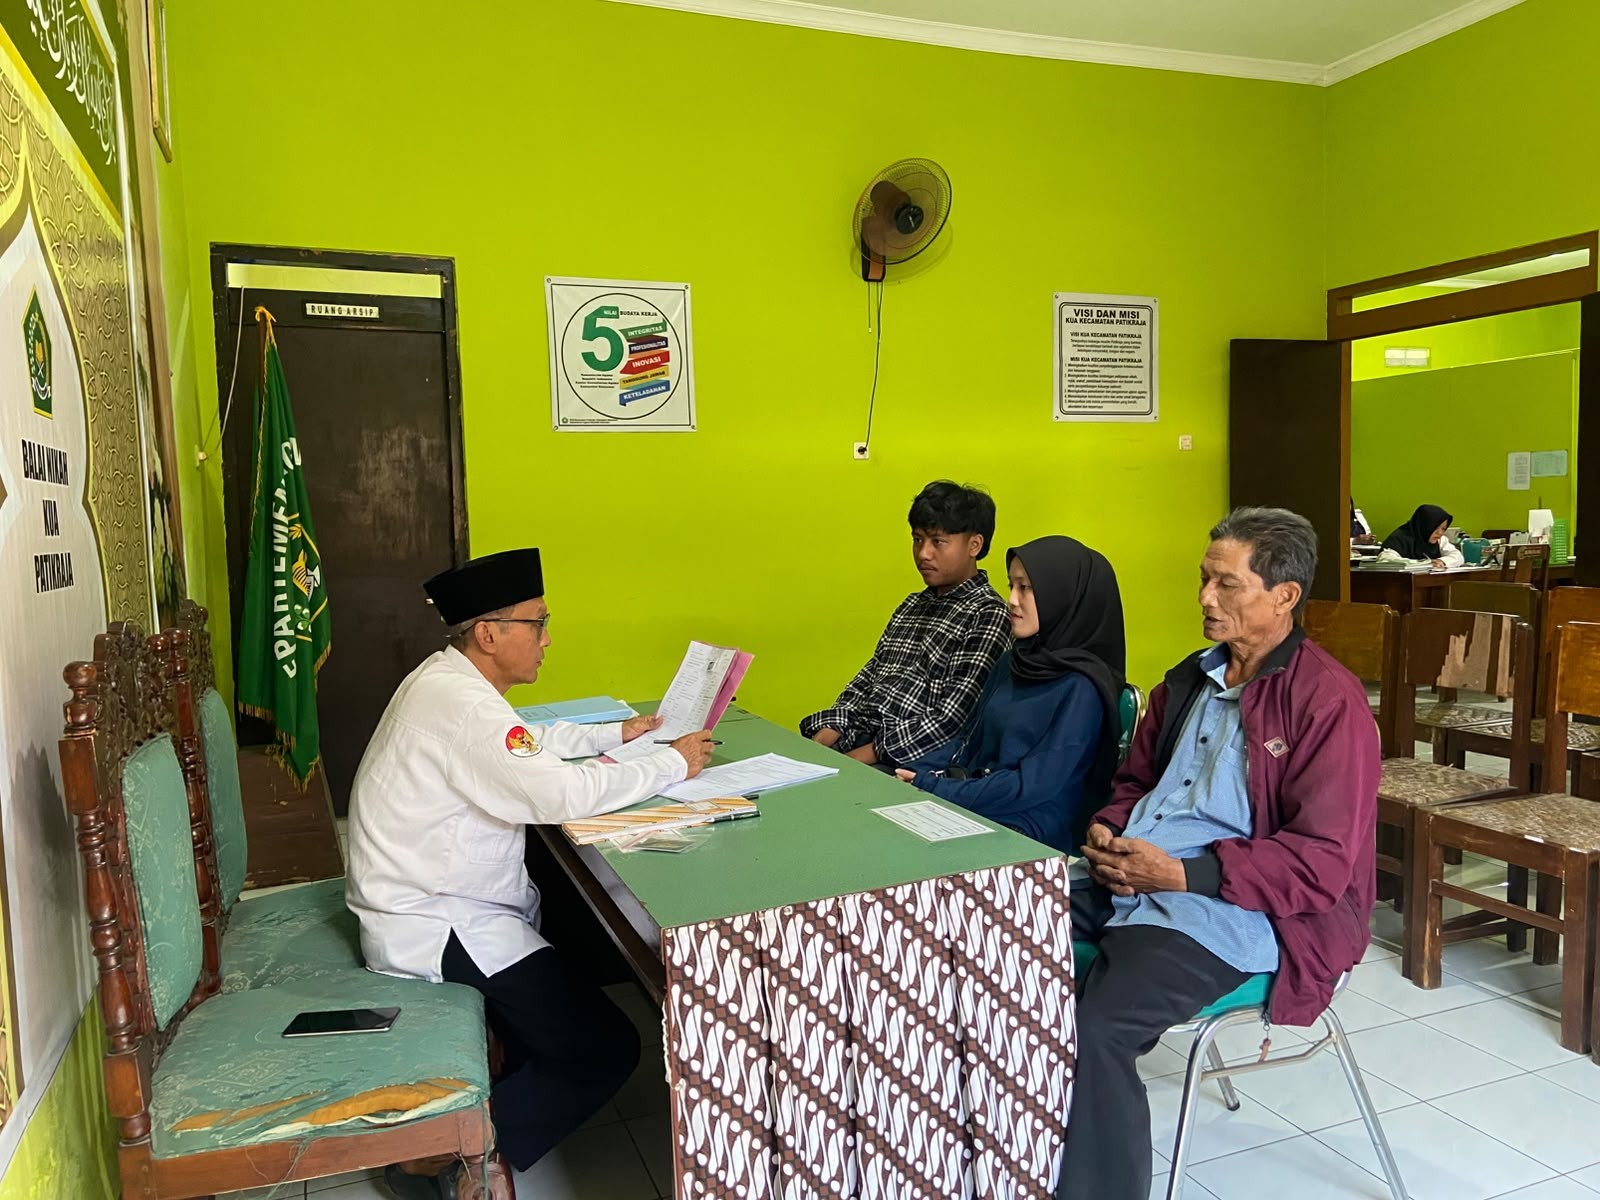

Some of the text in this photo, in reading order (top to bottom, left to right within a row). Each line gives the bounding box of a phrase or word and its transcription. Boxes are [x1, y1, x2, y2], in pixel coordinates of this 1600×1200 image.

[311, 305, 374, 316] RUANG ARSIP
[1073, 308, 1140, 319] VISI DAN MISI
[581, 305, 624, 372] 5
[627, 325, 664, 337] INTEGRITAS
[632, 356, 662, 368] INOVASI
[623, 385, 666, 400] KETELADANAN
[21, 439, 69, 486] BALAI NIKAH
[42, 499, 60, 536] KUA
[34, 552, 74, 594] PATIKRAJA
